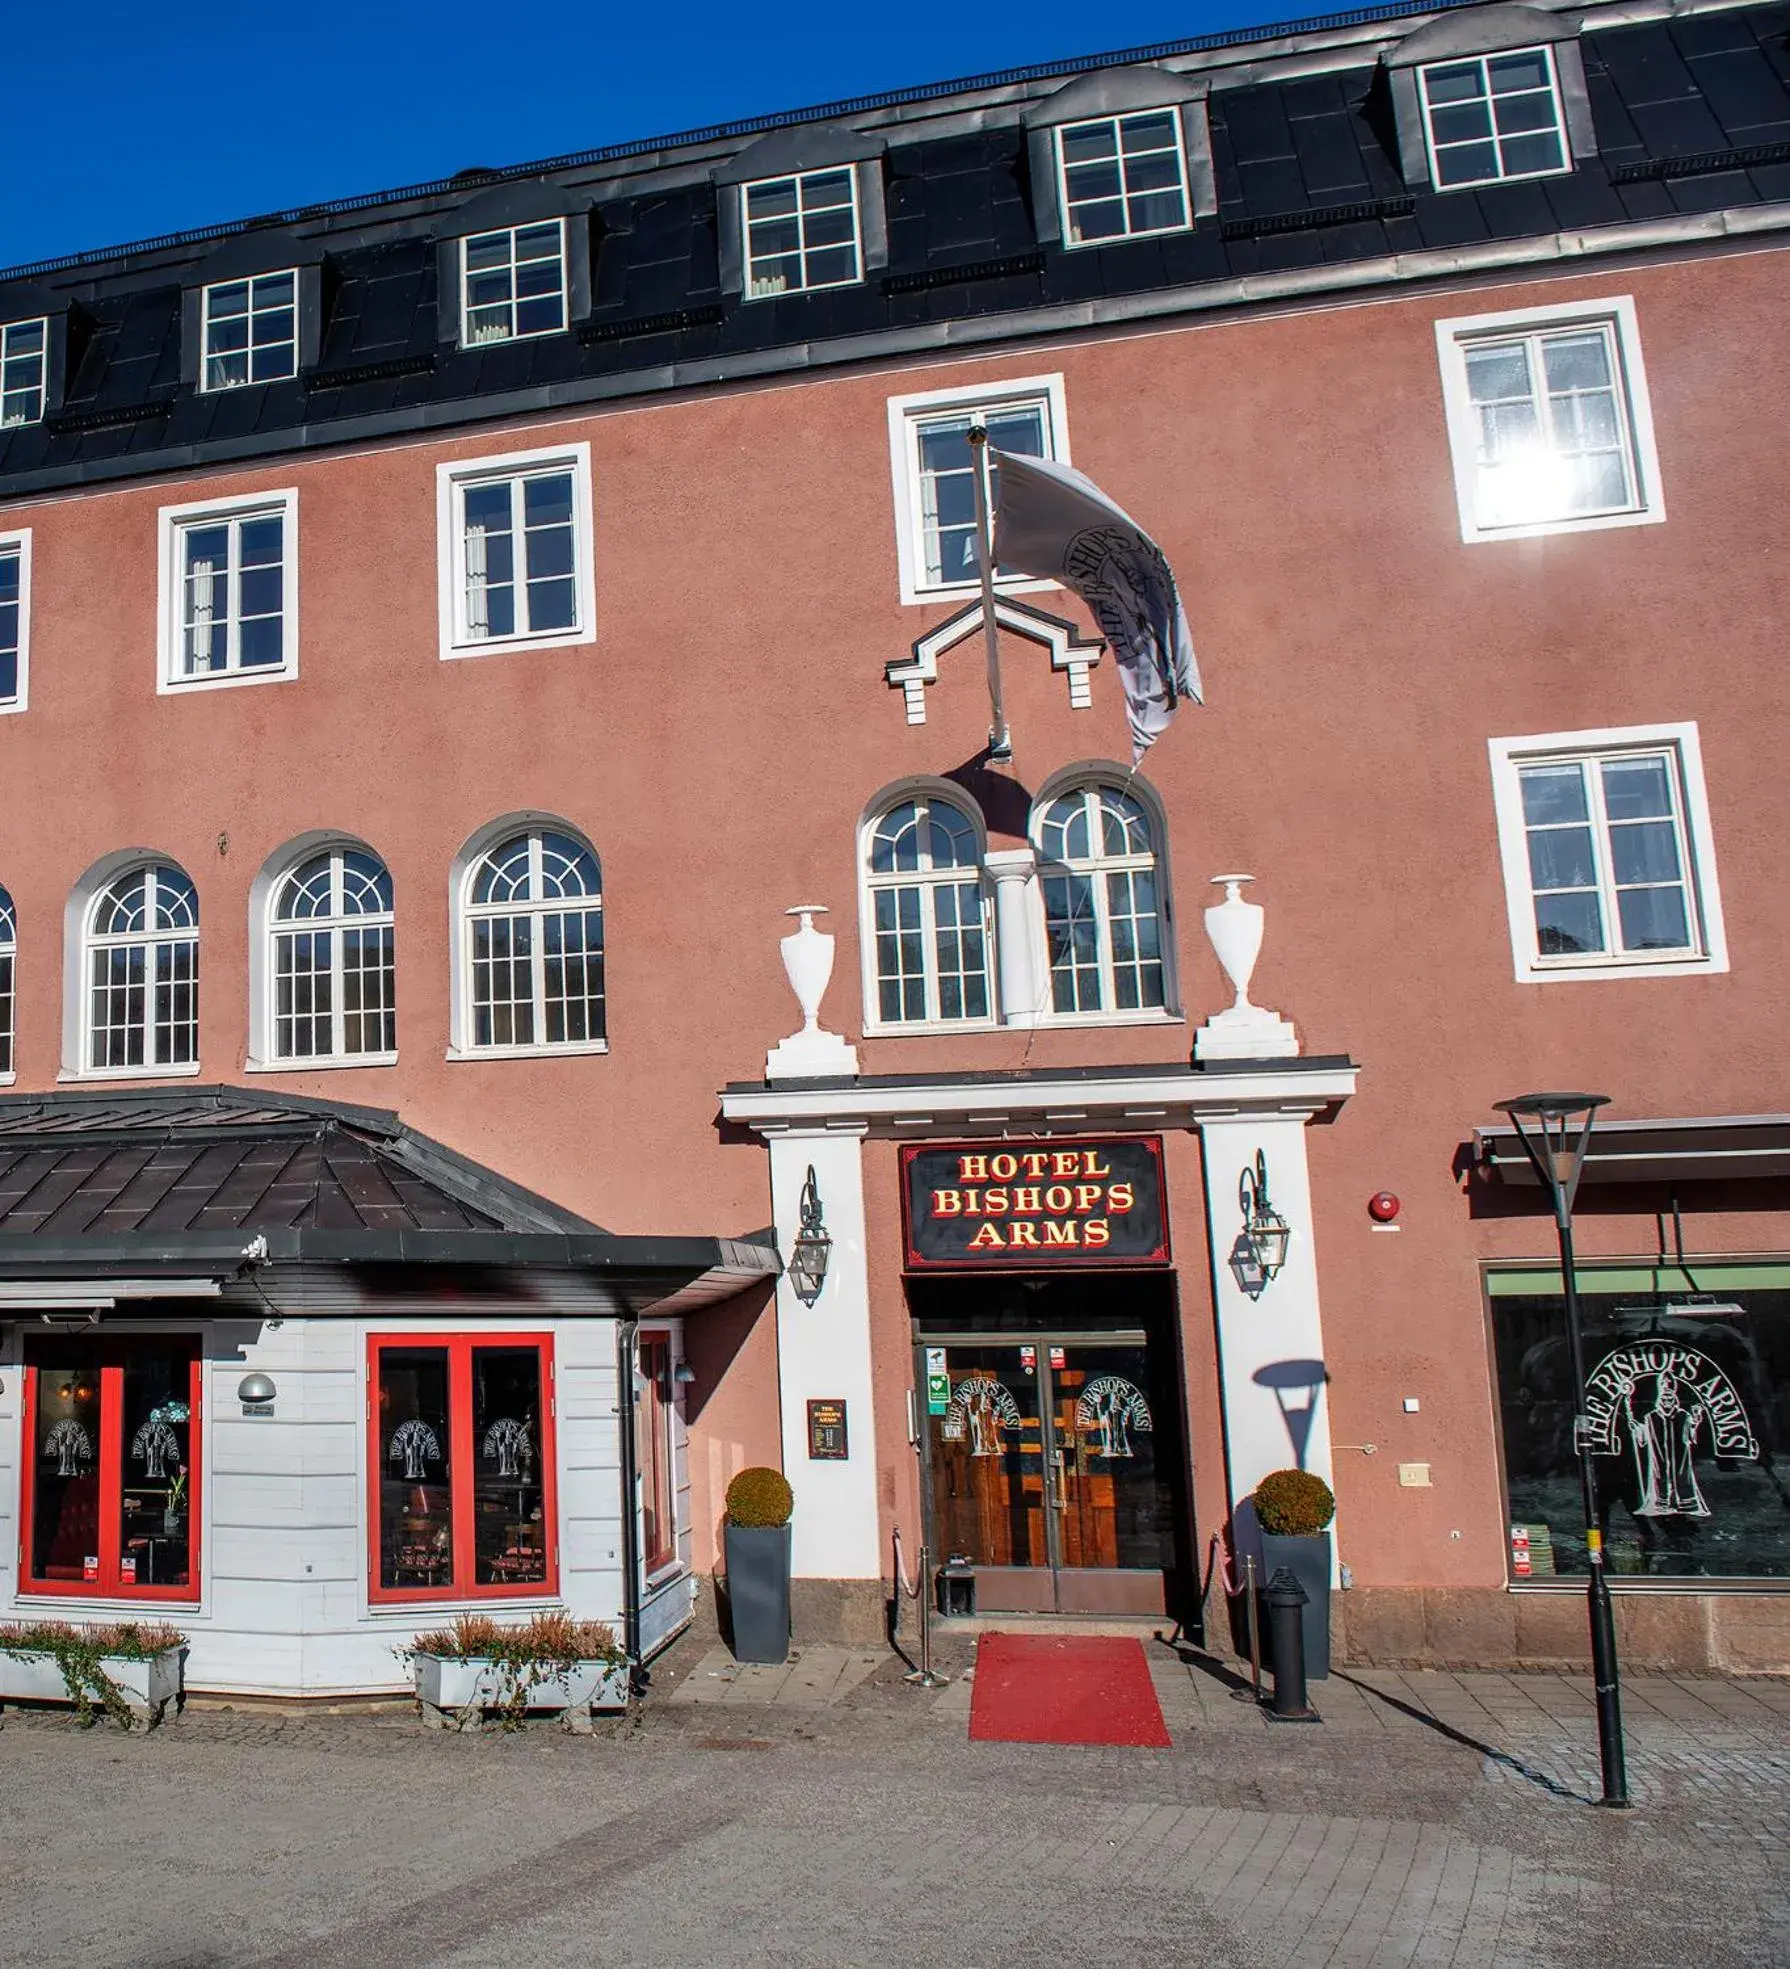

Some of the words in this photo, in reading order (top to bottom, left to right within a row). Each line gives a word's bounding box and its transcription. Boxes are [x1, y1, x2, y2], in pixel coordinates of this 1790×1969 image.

[959, 1151, 1110, 1182] HOTEL
[931, 1183, 1134, 1218] BISHOPS
[966, 1218, 1110, 1250] ARMS
[955, 1379, 1000, 1405] BISHOPS
[999, 1393, 1019, 1426] ARMS
[1083, 1379, 1130, 1405] BISHOPS
[1592, 1344, 1701, 1402] BISHOPS
[1694, 1375, 1748, 1449] ARMS
[1076, 1403, 1092, 1425] THE
[1128, 1393, 1149, 1427] ARMS
